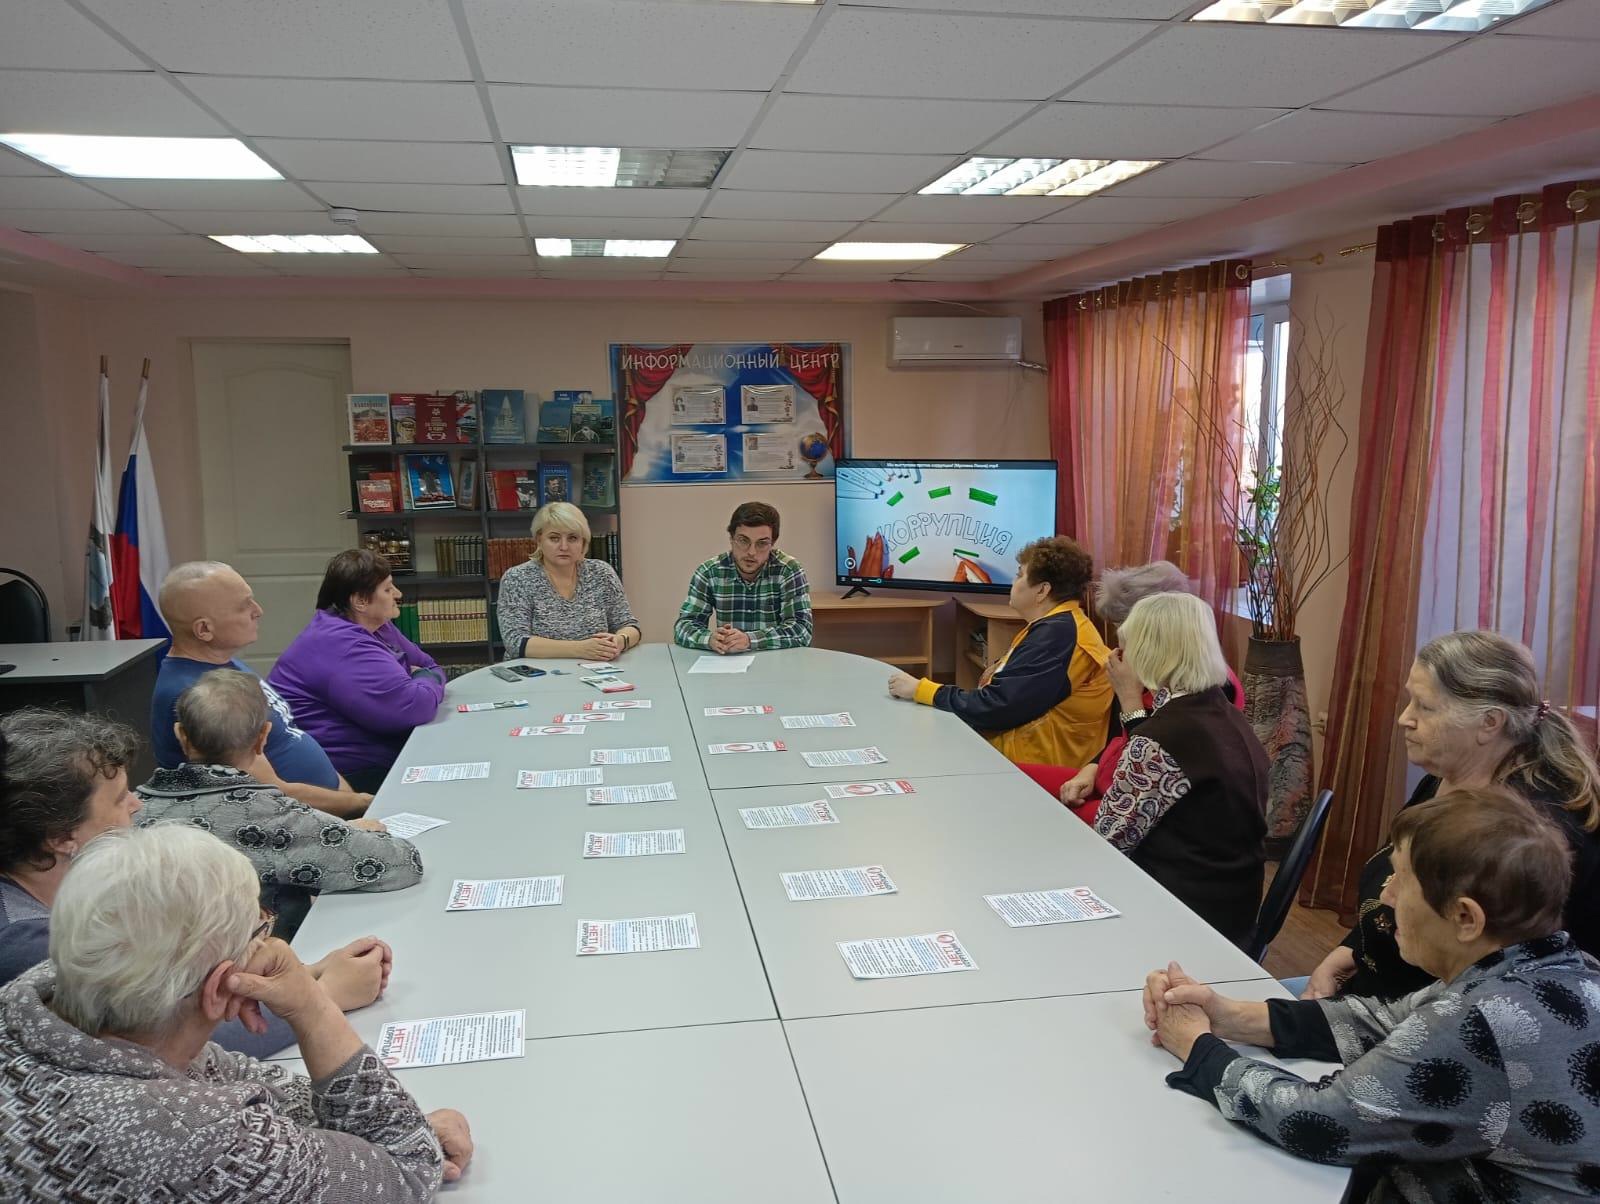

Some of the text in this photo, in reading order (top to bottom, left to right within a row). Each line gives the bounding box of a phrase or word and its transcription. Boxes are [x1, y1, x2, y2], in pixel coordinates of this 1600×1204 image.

[621, 349, 839, 373] ИНФОРМАЦИОННЫЙ ЦЕНТР
[878, 512, 1013, 555] КОРРУПЦИЯ
[461, 884, 472, 900] НЕТ!
[588, 925, 599, 945] НЕТ!
[941, 946, 963, 966] НЕТ!
[391, 1028, 406, 1053] НЕТ!
